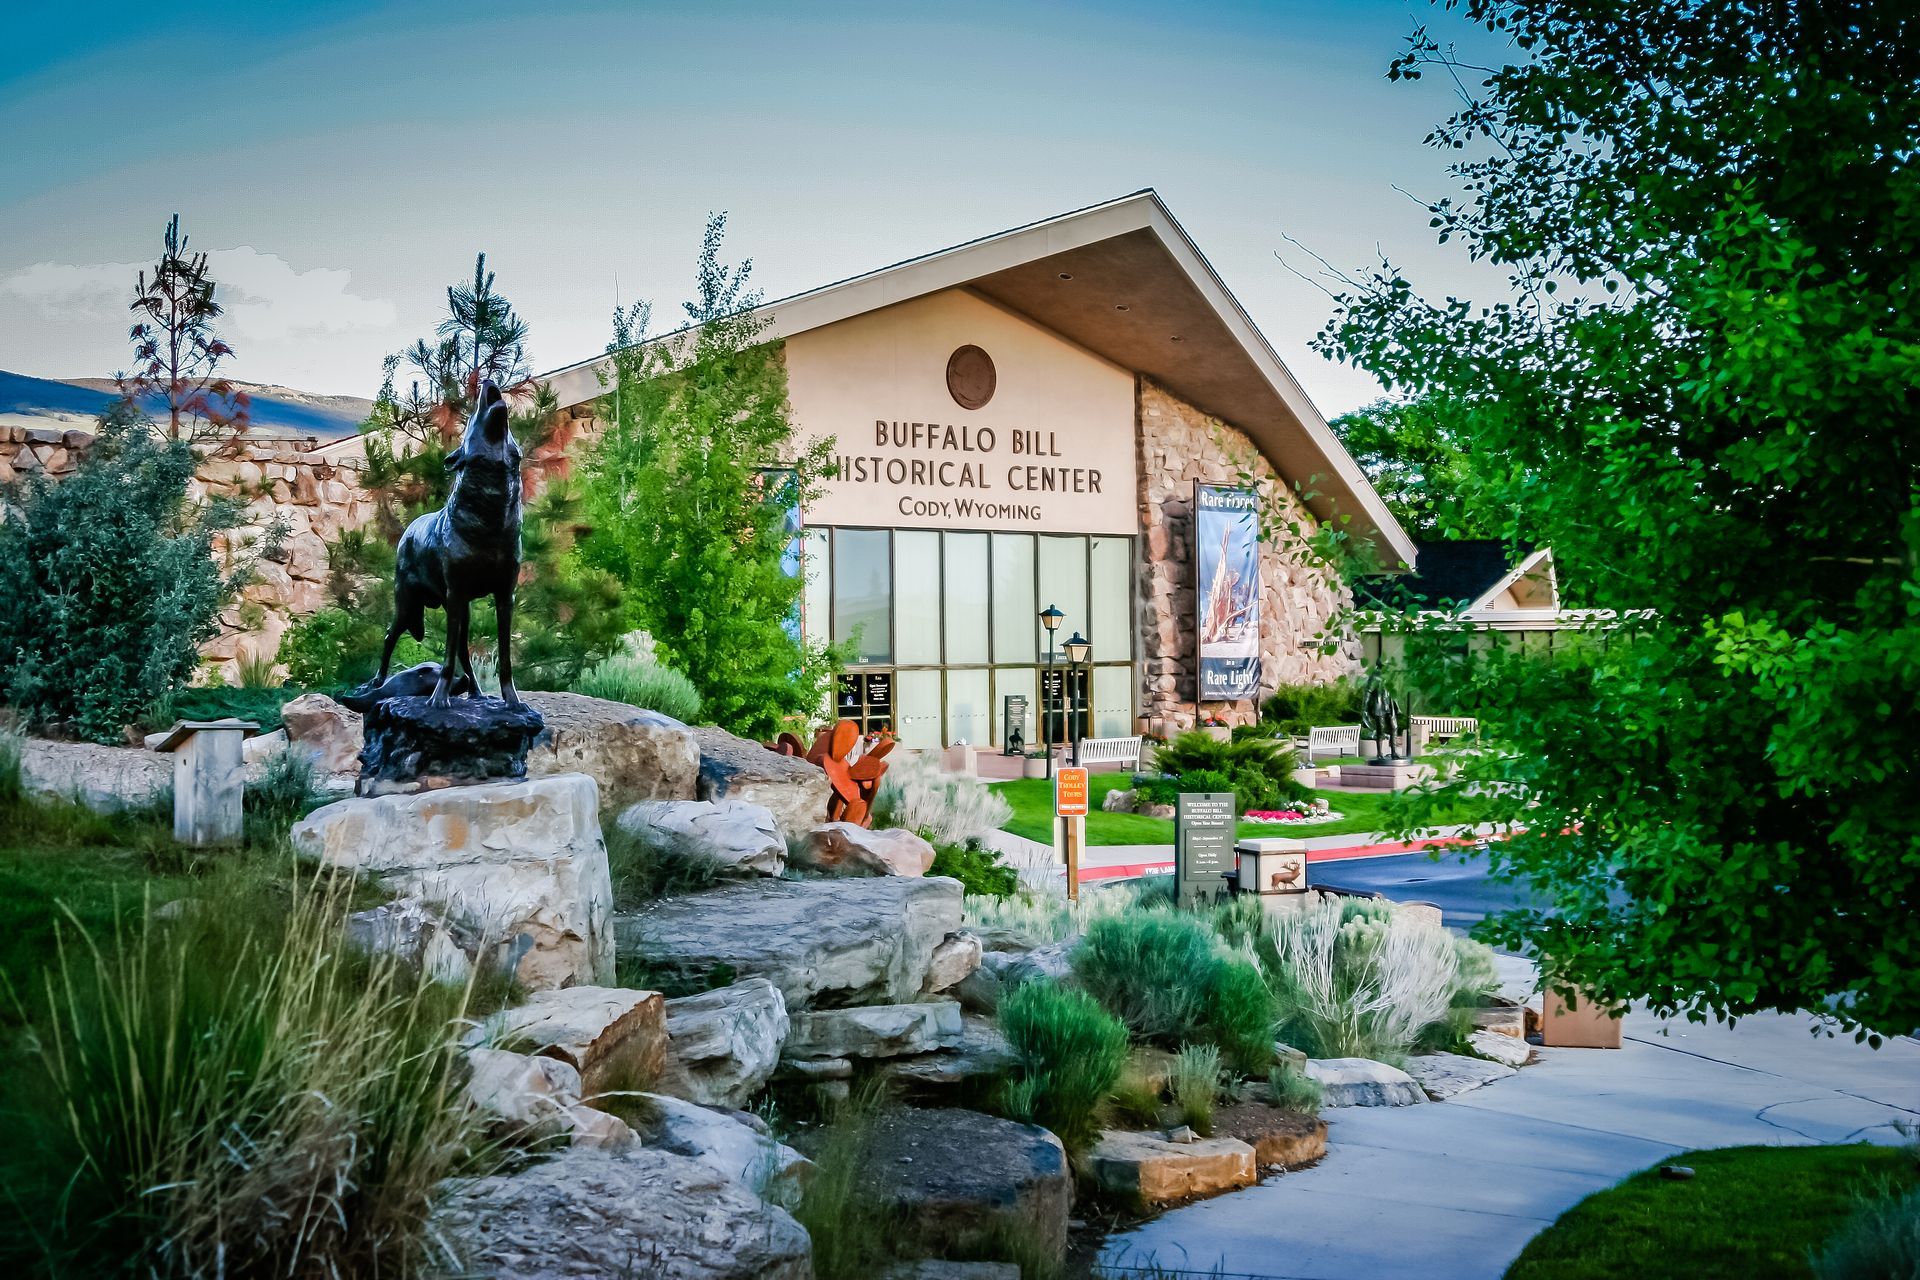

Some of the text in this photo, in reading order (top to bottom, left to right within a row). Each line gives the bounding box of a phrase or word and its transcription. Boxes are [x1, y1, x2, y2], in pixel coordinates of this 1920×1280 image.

[876, 420, 1062, 457] BUFFALO BILL
[826, 455, 991, 489] HISTORICAL
[1008, 465, 1102, 494] CENTER
[1201, 491, 1224, 507] Rare
[1207, 669, 1253, 689] Rare Light
